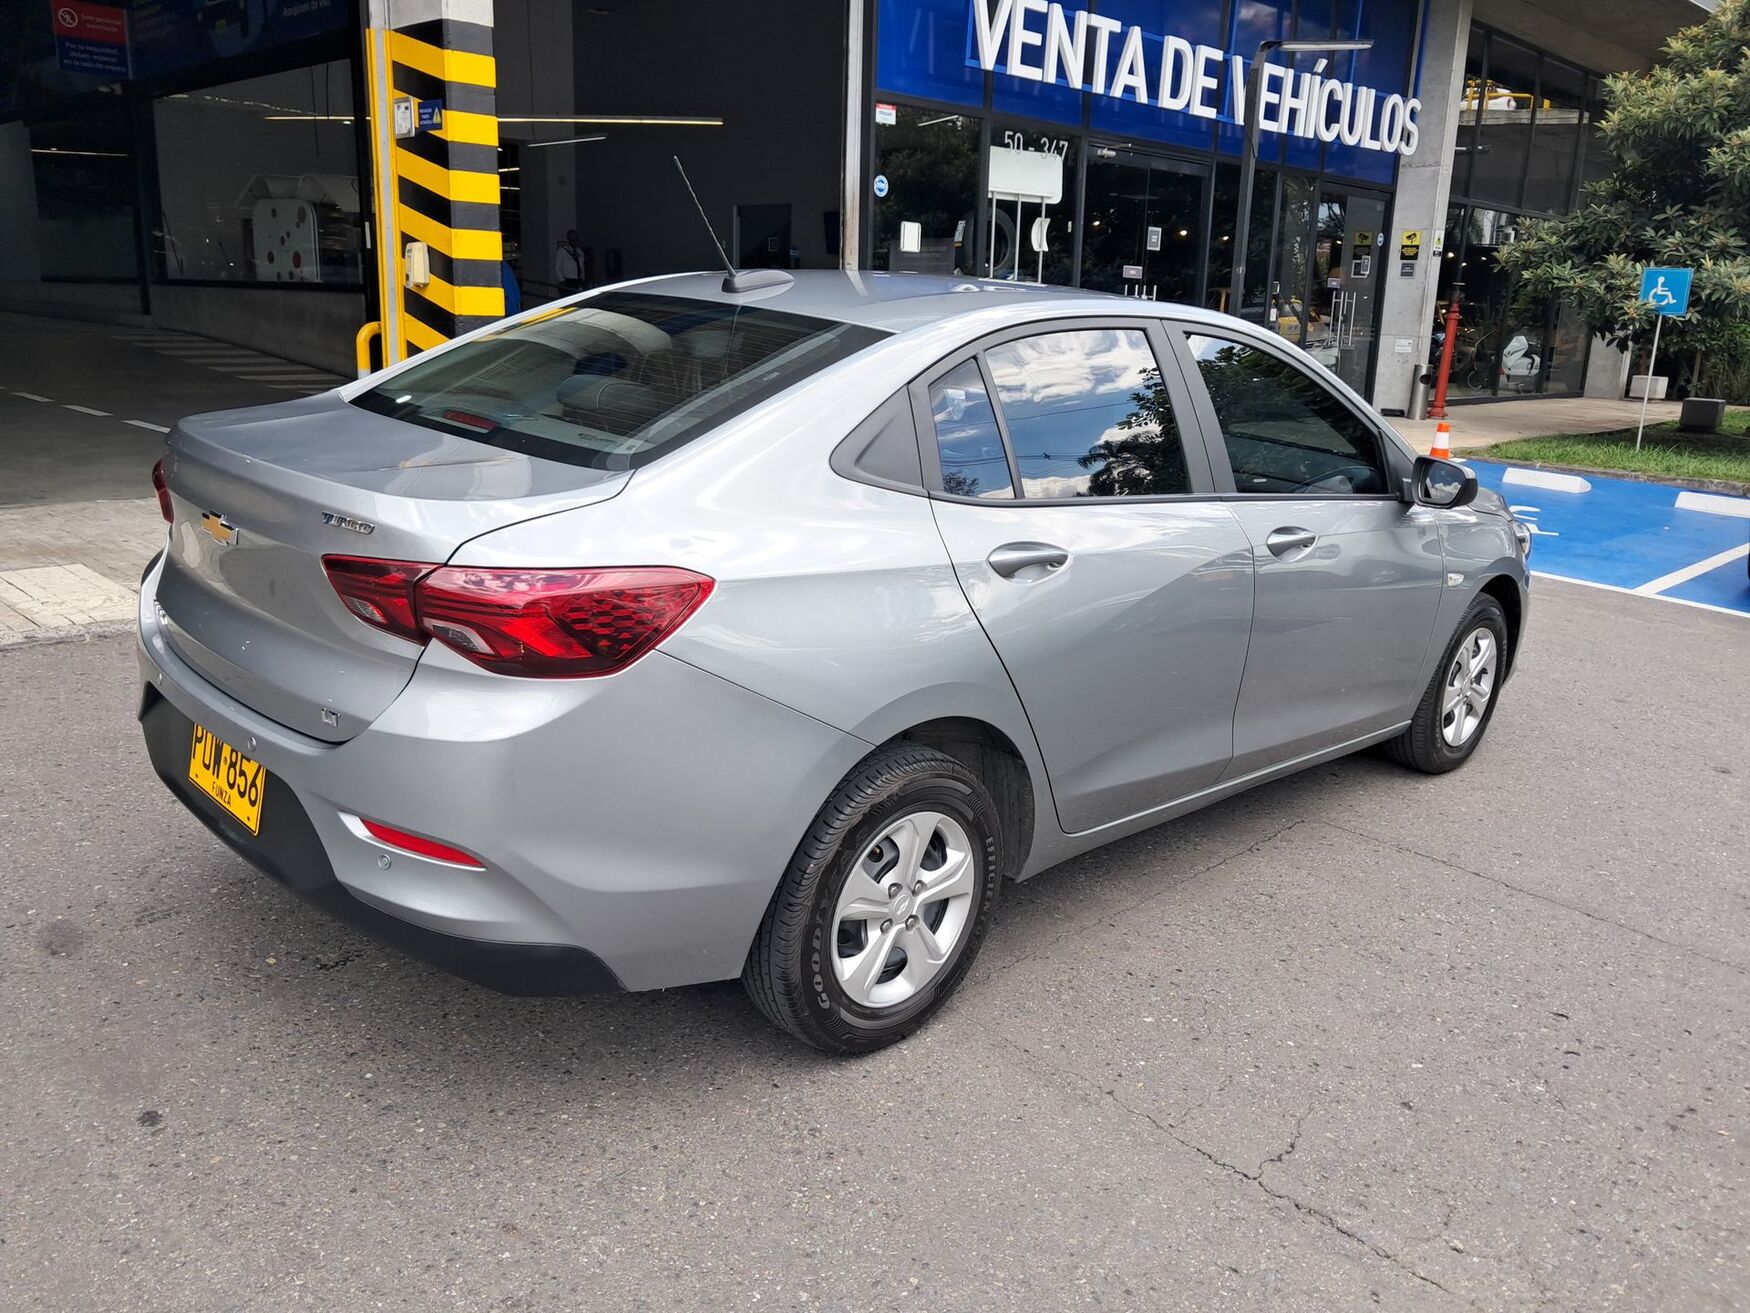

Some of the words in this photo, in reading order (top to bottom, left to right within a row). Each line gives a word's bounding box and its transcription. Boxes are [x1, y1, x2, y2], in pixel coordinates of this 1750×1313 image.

[973, 0, 1149, 104] VENTA
[1157, 34, 1224, 119] DE
[1004, 130, 1024, 152] 50
[211, 780, 232, 807] FUNZA
[226, 747, 259, 808] 856
